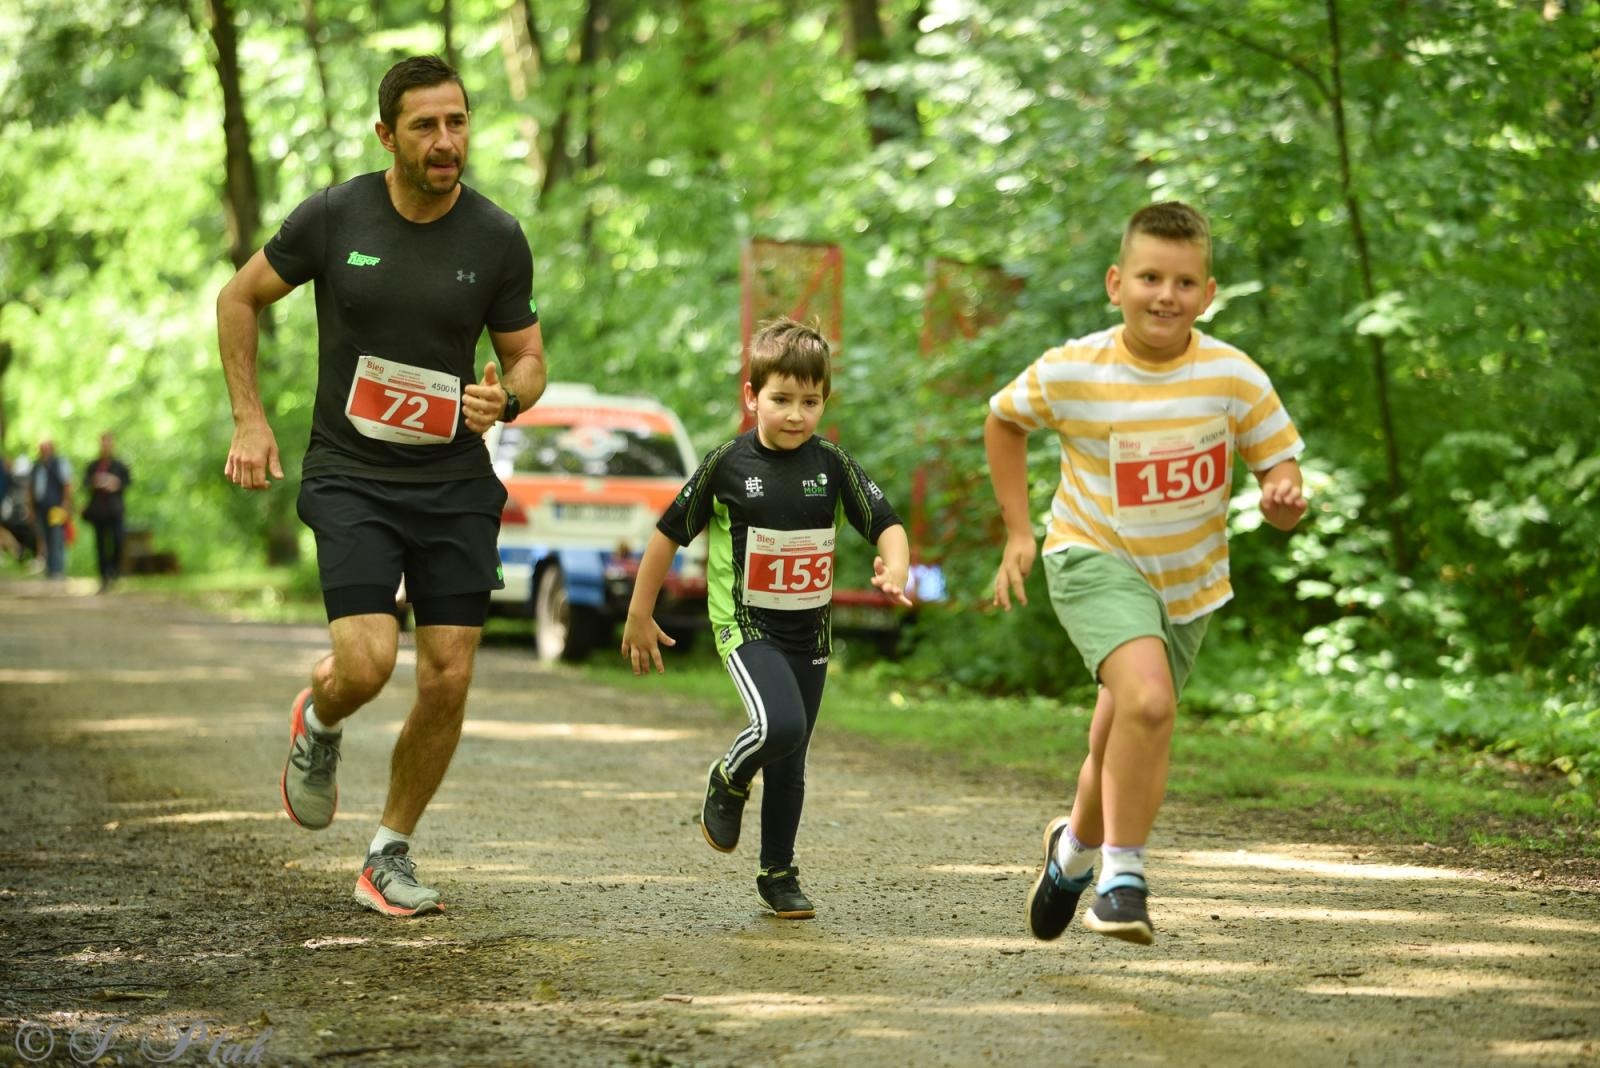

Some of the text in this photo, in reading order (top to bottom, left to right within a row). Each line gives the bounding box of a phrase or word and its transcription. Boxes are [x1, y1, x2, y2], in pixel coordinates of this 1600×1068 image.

[366, 360, 385, 374] Bieg
[431, 382, 450, 393] 4500
[380, 389, 429, 429] 72
[1137, 454, 1215, 502] 150
[756, 534, 776, 545] Bieg
[768, 555, 832, 591] 153
